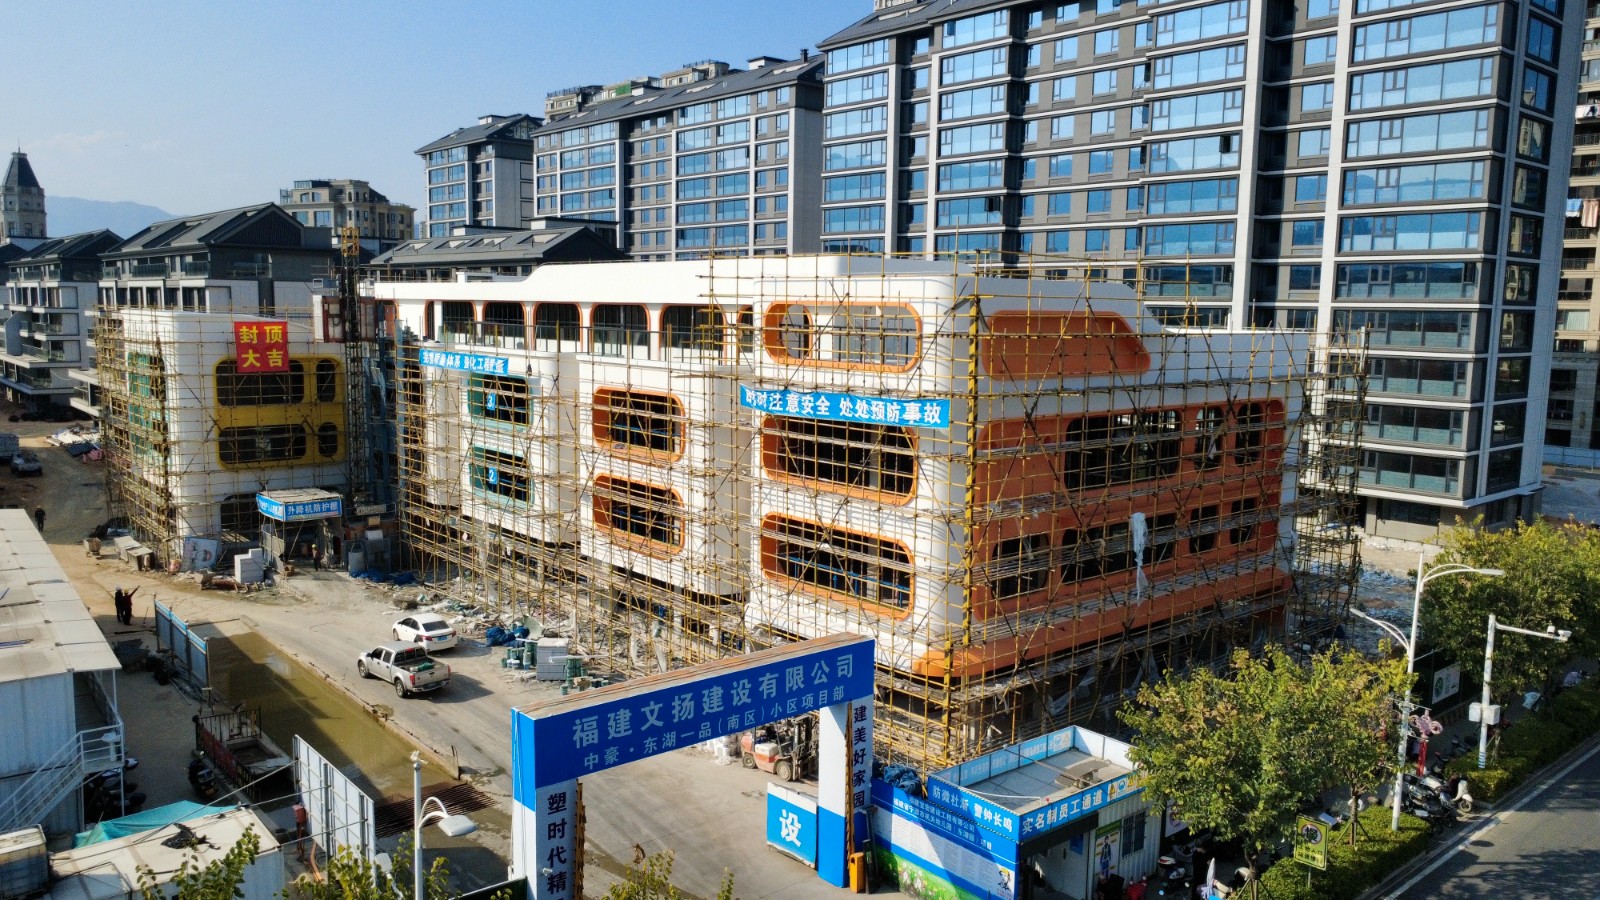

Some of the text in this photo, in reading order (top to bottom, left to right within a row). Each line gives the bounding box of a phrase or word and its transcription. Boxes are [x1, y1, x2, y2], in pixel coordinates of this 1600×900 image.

[239, 325, 283, 344] 封顶
[241, 348, 284, 368] 大吉
[487, 395, 493, 408] 3
[839, 397, 941, 425] 处处预防事故
[489, 469, 494, 482] 2
[573, 653, 853, 749] 福建文扬建设有限公司
[853, 705, 867, 809] 建美好家园
[779, 808, 802, 847] 设
[932, 785, 1013, 833] 防微杜渐 警钟长鸣
[1022, 789, 1103, 836] 实名制员工通道
[547, 791, 568, 900] 塑时代精
